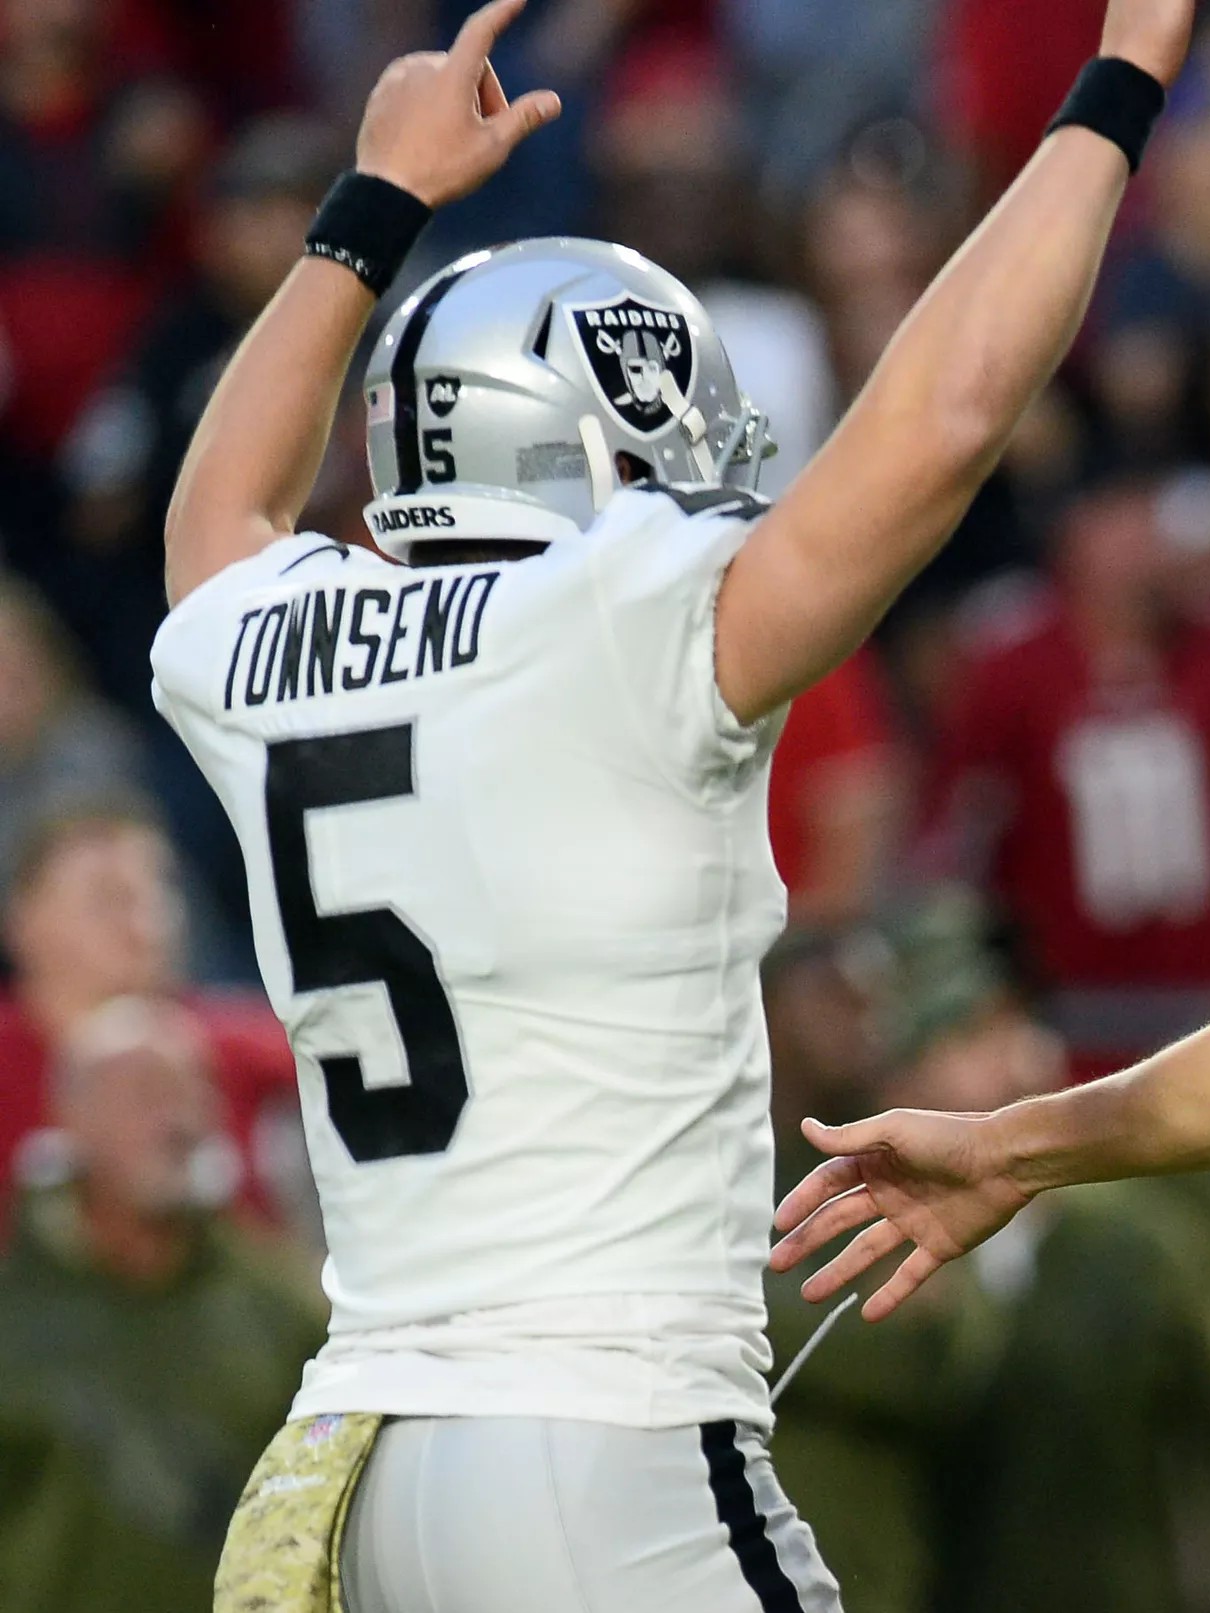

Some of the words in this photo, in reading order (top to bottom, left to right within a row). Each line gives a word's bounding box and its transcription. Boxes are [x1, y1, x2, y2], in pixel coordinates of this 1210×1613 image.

[585, 308, 681, 330] RAIDERS
[422, 428, 457, 484] 5
[223, 571, 501, 711] TOWNSEND
[264, 716, 473, 1164] 5
